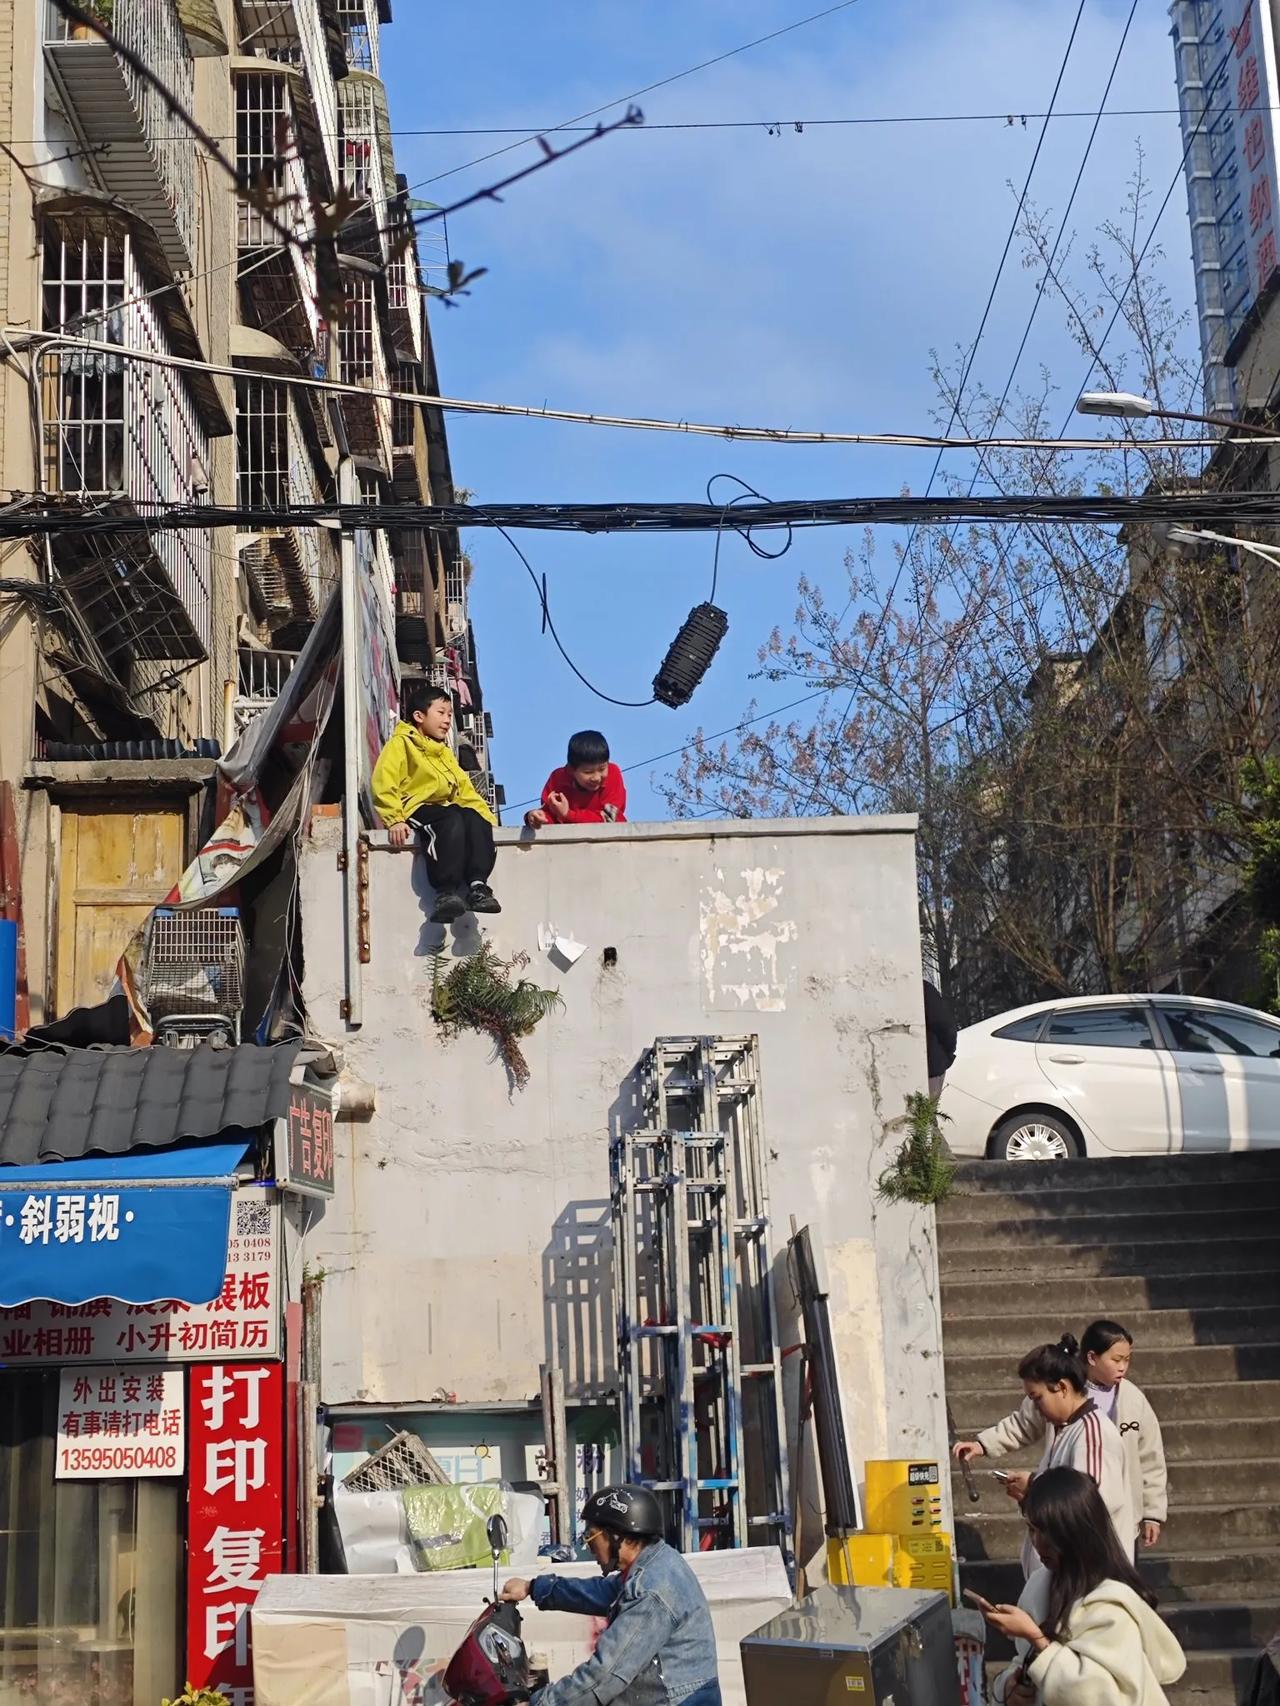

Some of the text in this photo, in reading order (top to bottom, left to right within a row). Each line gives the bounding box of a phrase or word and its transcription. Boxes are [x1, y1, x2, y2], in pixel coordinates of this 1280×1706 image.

[289, 1094, 333, 1182] 广告复印
[243, 1238, 271, 1249] 0408
[243, 1252, 271, 1262] 3179
[116, 1319, 269, 1353] 小升初简历
[73, 1375, 166, 1404] 外出安装
[62, 1408, 181, 1439] 有事请打电话
[61, 1446, 177, 1471] 13595050408
